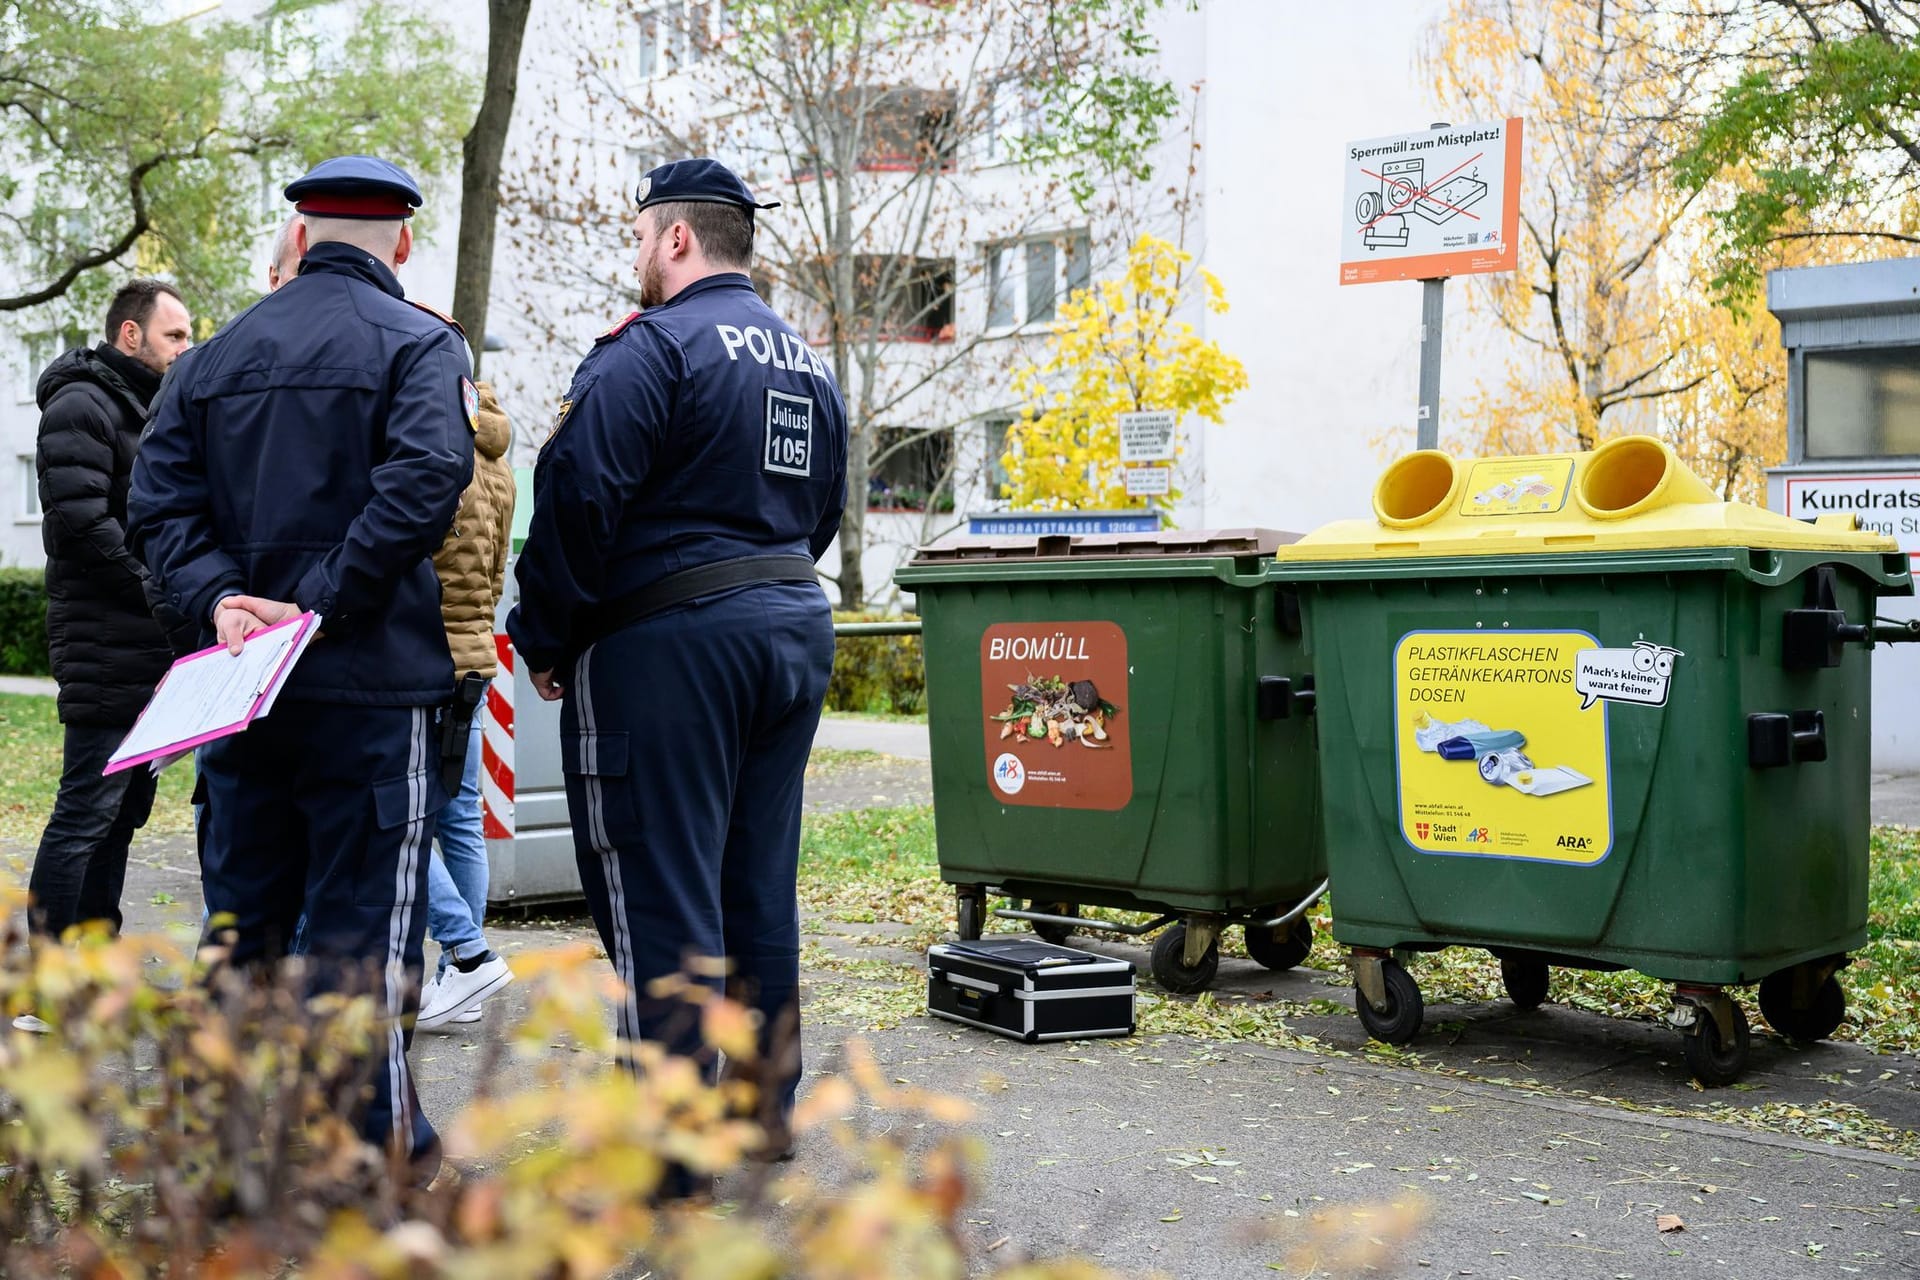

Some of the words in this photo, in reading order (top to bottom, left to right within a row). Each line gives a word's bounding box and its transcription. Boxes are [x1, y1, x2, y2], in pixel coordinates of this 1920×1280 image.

[1350, 140, 1408, 162] Sperrmüll
[1410, 139, 1434, 151] zum
[1437, 128, 1500, 148] Mistplatz!
[716, 324, 828, 380] POLIZE
[772, 404, 808, 431] Julius
[771, 435, 807, 466] 105
[1802, 489, 1920, 509] Kundrats
[981, 521, 1100, 534] KUNDRATSTRASSE
[989, 632, 1090, 660] BIOMÜLL
[1408, 646, 1559, 662] PLASTIKFLASCHEN
[1409, 664, 1573, 684] GETRÄNKEKARTONS
[1582, 665, 1619, 678] Mach's
[1621, 670, 1660, 686] kleiner,
[1409, 687, 1466, 703] DOSEN
[1588, 680, 1619, 691] warat
[1621, 682, 1653, 696] feiner
[1433, 823, 1457, 833] Stadt
[1433, 833, 1457, 842] Wien
[1556, 835, 1587, 849] ARA
